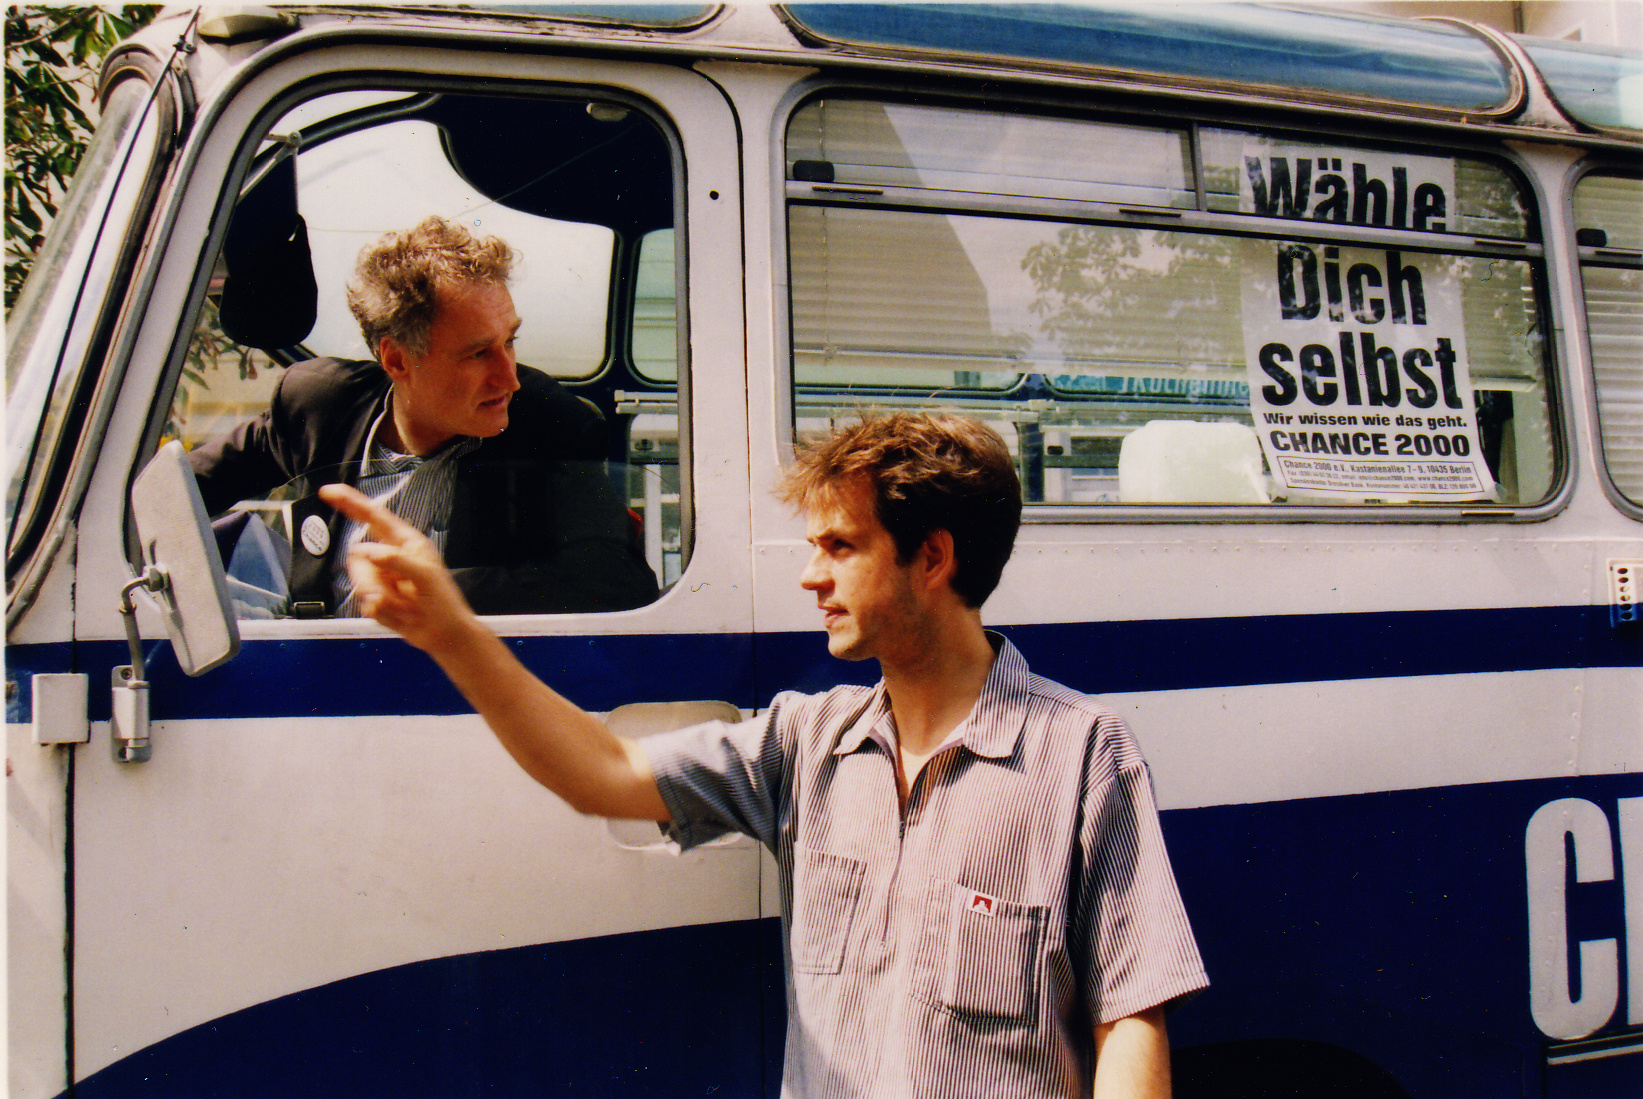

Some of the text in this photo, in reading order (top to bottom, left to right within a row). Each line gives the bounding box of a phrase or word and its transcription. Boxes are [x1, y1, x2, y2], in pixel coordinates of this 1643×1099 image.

[1245, 156, 1447, 231] Wähle
[1277, 243, 1428, 325] Dich
[1258, 331, 1464, 409] selbst
[1263, 412, 1468, 430] Wir wissen wie das geht.
[1270, 430, 1471, 457] CHANCE 2000
[1283, 460, 1313, 470] Chance
[1314, 461, 1332, 471] 2000
[1350, 464, 1405, 474] Kastanienallee
[1427, 465, 1448, 474] 10435
[1449, 465, 1472, 474] Berlin
